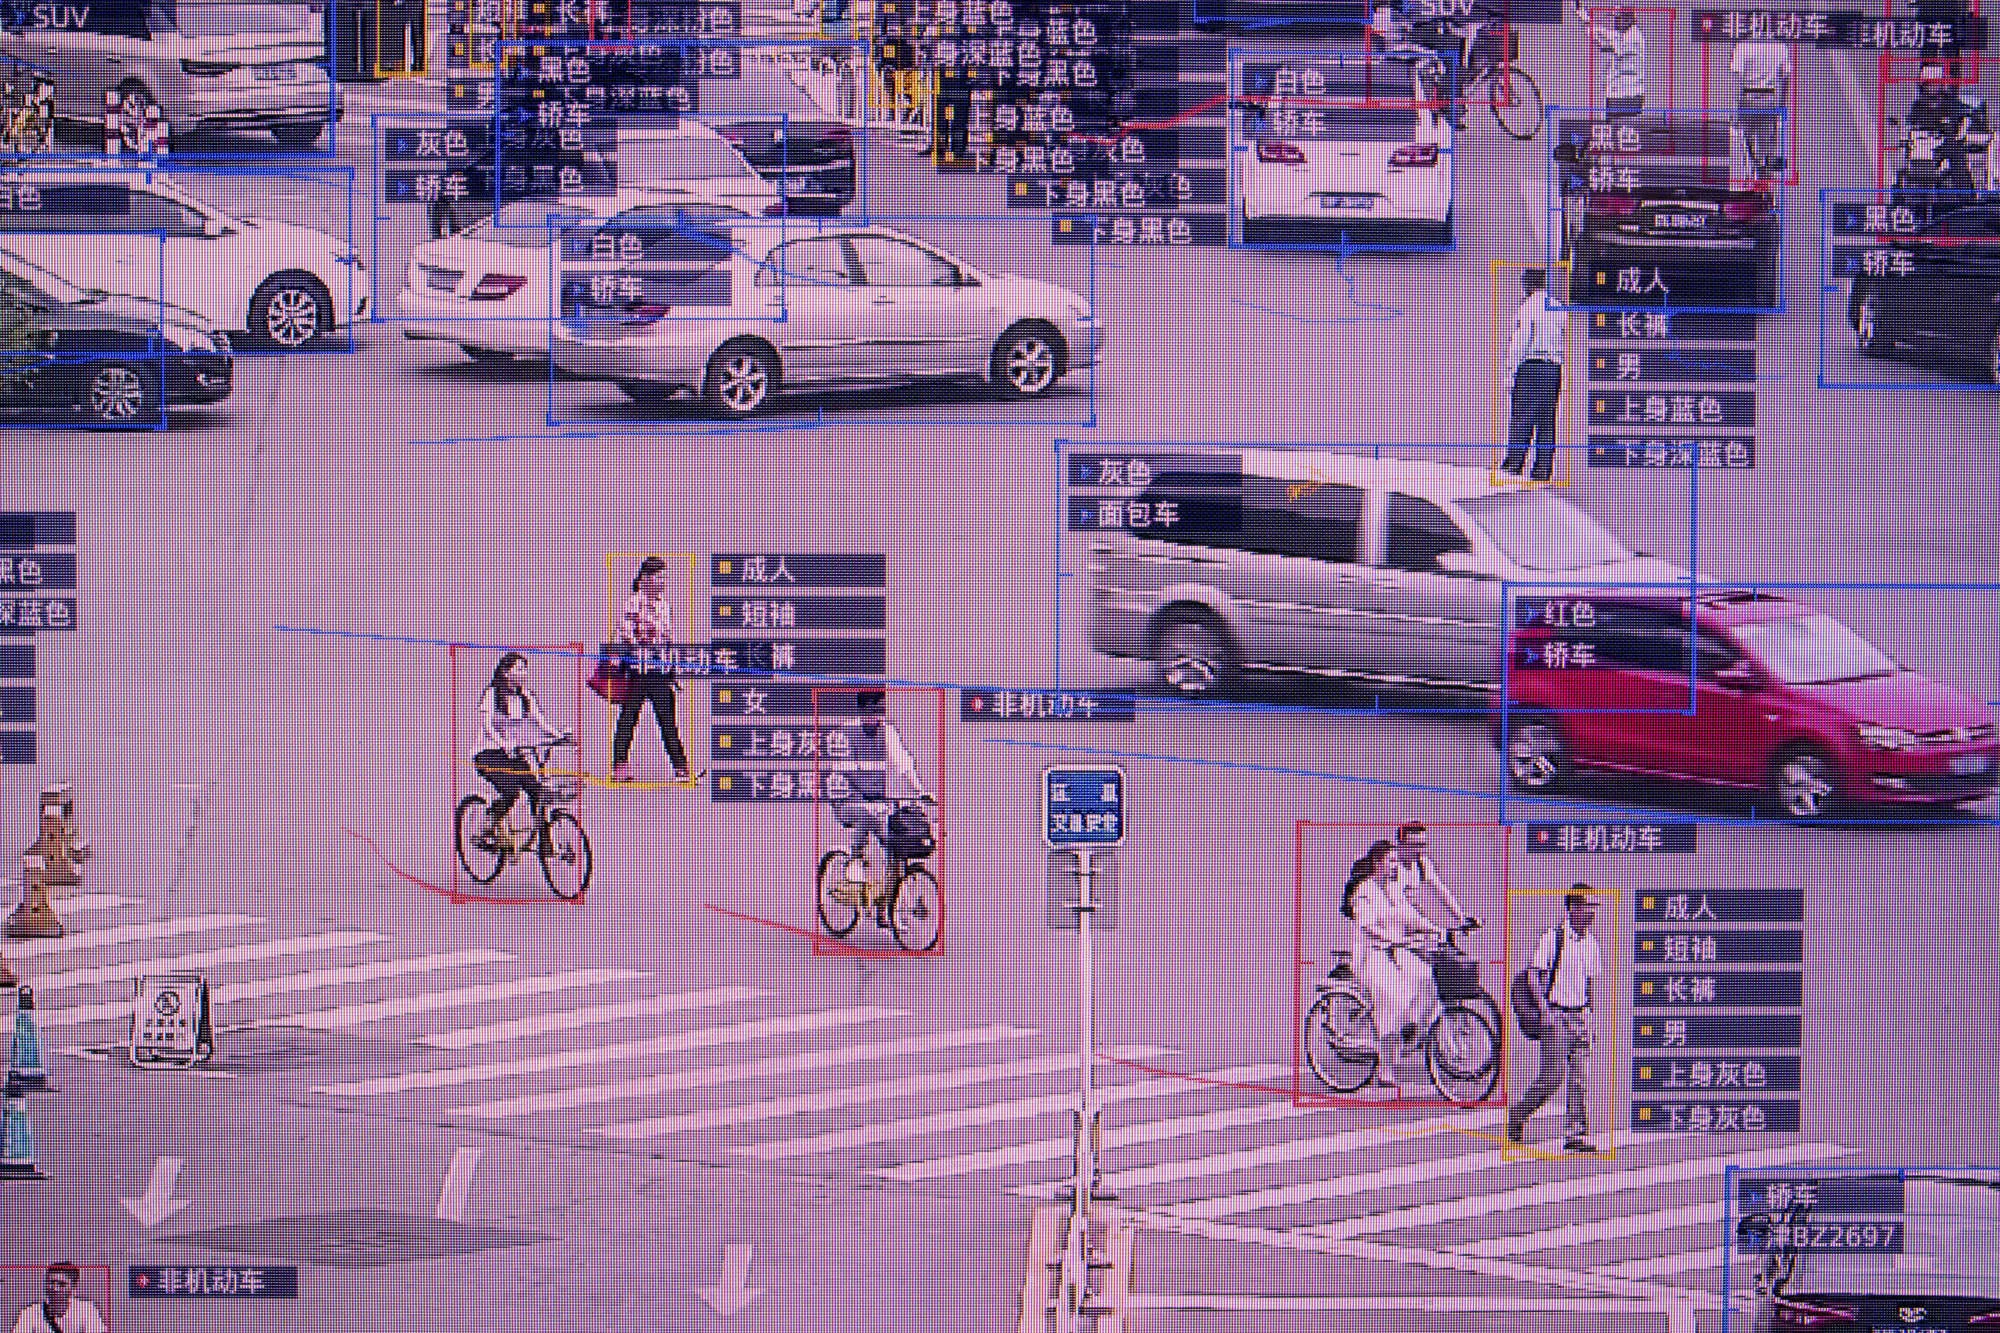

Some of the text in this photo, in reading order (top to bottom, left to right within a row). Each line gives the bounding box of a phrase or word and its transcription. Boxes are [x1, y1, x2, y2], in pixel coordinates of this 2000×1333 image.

[34, 6, 89, 28] SUV
[905, 0, 1013, 25] 上身蓝色
[1421, 0, 1475, 16] SUV
[1722, 12, 1829, 39] 非机动车
[1846, 21, 1953, 48] 非机动车
[905, 39, 1042, 67] 下身深蓝色
[538, 56, 591, 84] 黑色
[1274, 68, 1327, 96] 白色
[537, 101, 592, 129] 轿车
[968, 104, 1075, 132] 上身蓝色
[1273, 110, 1327, 137] 轿车
[415, 130, 469, 158] 灰色
[1589, 124, 1642, 152] 黑色
[967, 146, 1076, 174] 下身黑色
[414, 174, 470, 201] 轿车
[1588, 166, 1642, 193] 轿车
[1037, 180, 1146, 207] 下身黑色
[1090, 217, 1192, 245] 下身黑色
[1863, 205, 1917, 233] 黑色
[592, 233, 644, 261] 白色
[1863, 250, 1916, 277] 轿车
[590, 275, 644, 302] 轿车
[1616, 267, 1670, 294] 成人
[1616, 311, 1670, 338] 长裤
[1616, 353, 1641, 380] 男
[1616, 395, 1723, 423] 上身蓝色
[1616, 440, 1749, 468] 下身深蓝色
[1098, 458, 1152, 486] 灰色
[1098, 500, 1180, 529] 面包车
[741, 556, 796, 583] 成人
[741, 601, 796, 628] 短袖
[1543, 600, 1597, 628] 红色
[630, 647, 740, 675] 非机动车
[1543, 641, 1597, 668] 轿车
[742, 688, 768, 715] 女
[991, 691, 1099, 718] 非机动车
[741, 730, 851, 758] 上身灰色
[741, 773, 851, 800] 下身黑色
[1557, 825, 1663, 852] 非机动车
[1664, 894, 1718, 921] 成人
[1663, 935, 1718, 962] 短袖
[1663, 976, 1717, 1003] 长裤
[1662, 1020, 1688, 1047] 男
[1662, 1061, 1768, 1088] 上身灰色
[1661, 1104, 1768, 1132] 下身灰色
[1765, 1183, 1819, 1210] 轿车
[1766, 1224, 1896, 1250] 津BZ2697
[157, 1268, 266, 1296] 非机动车
